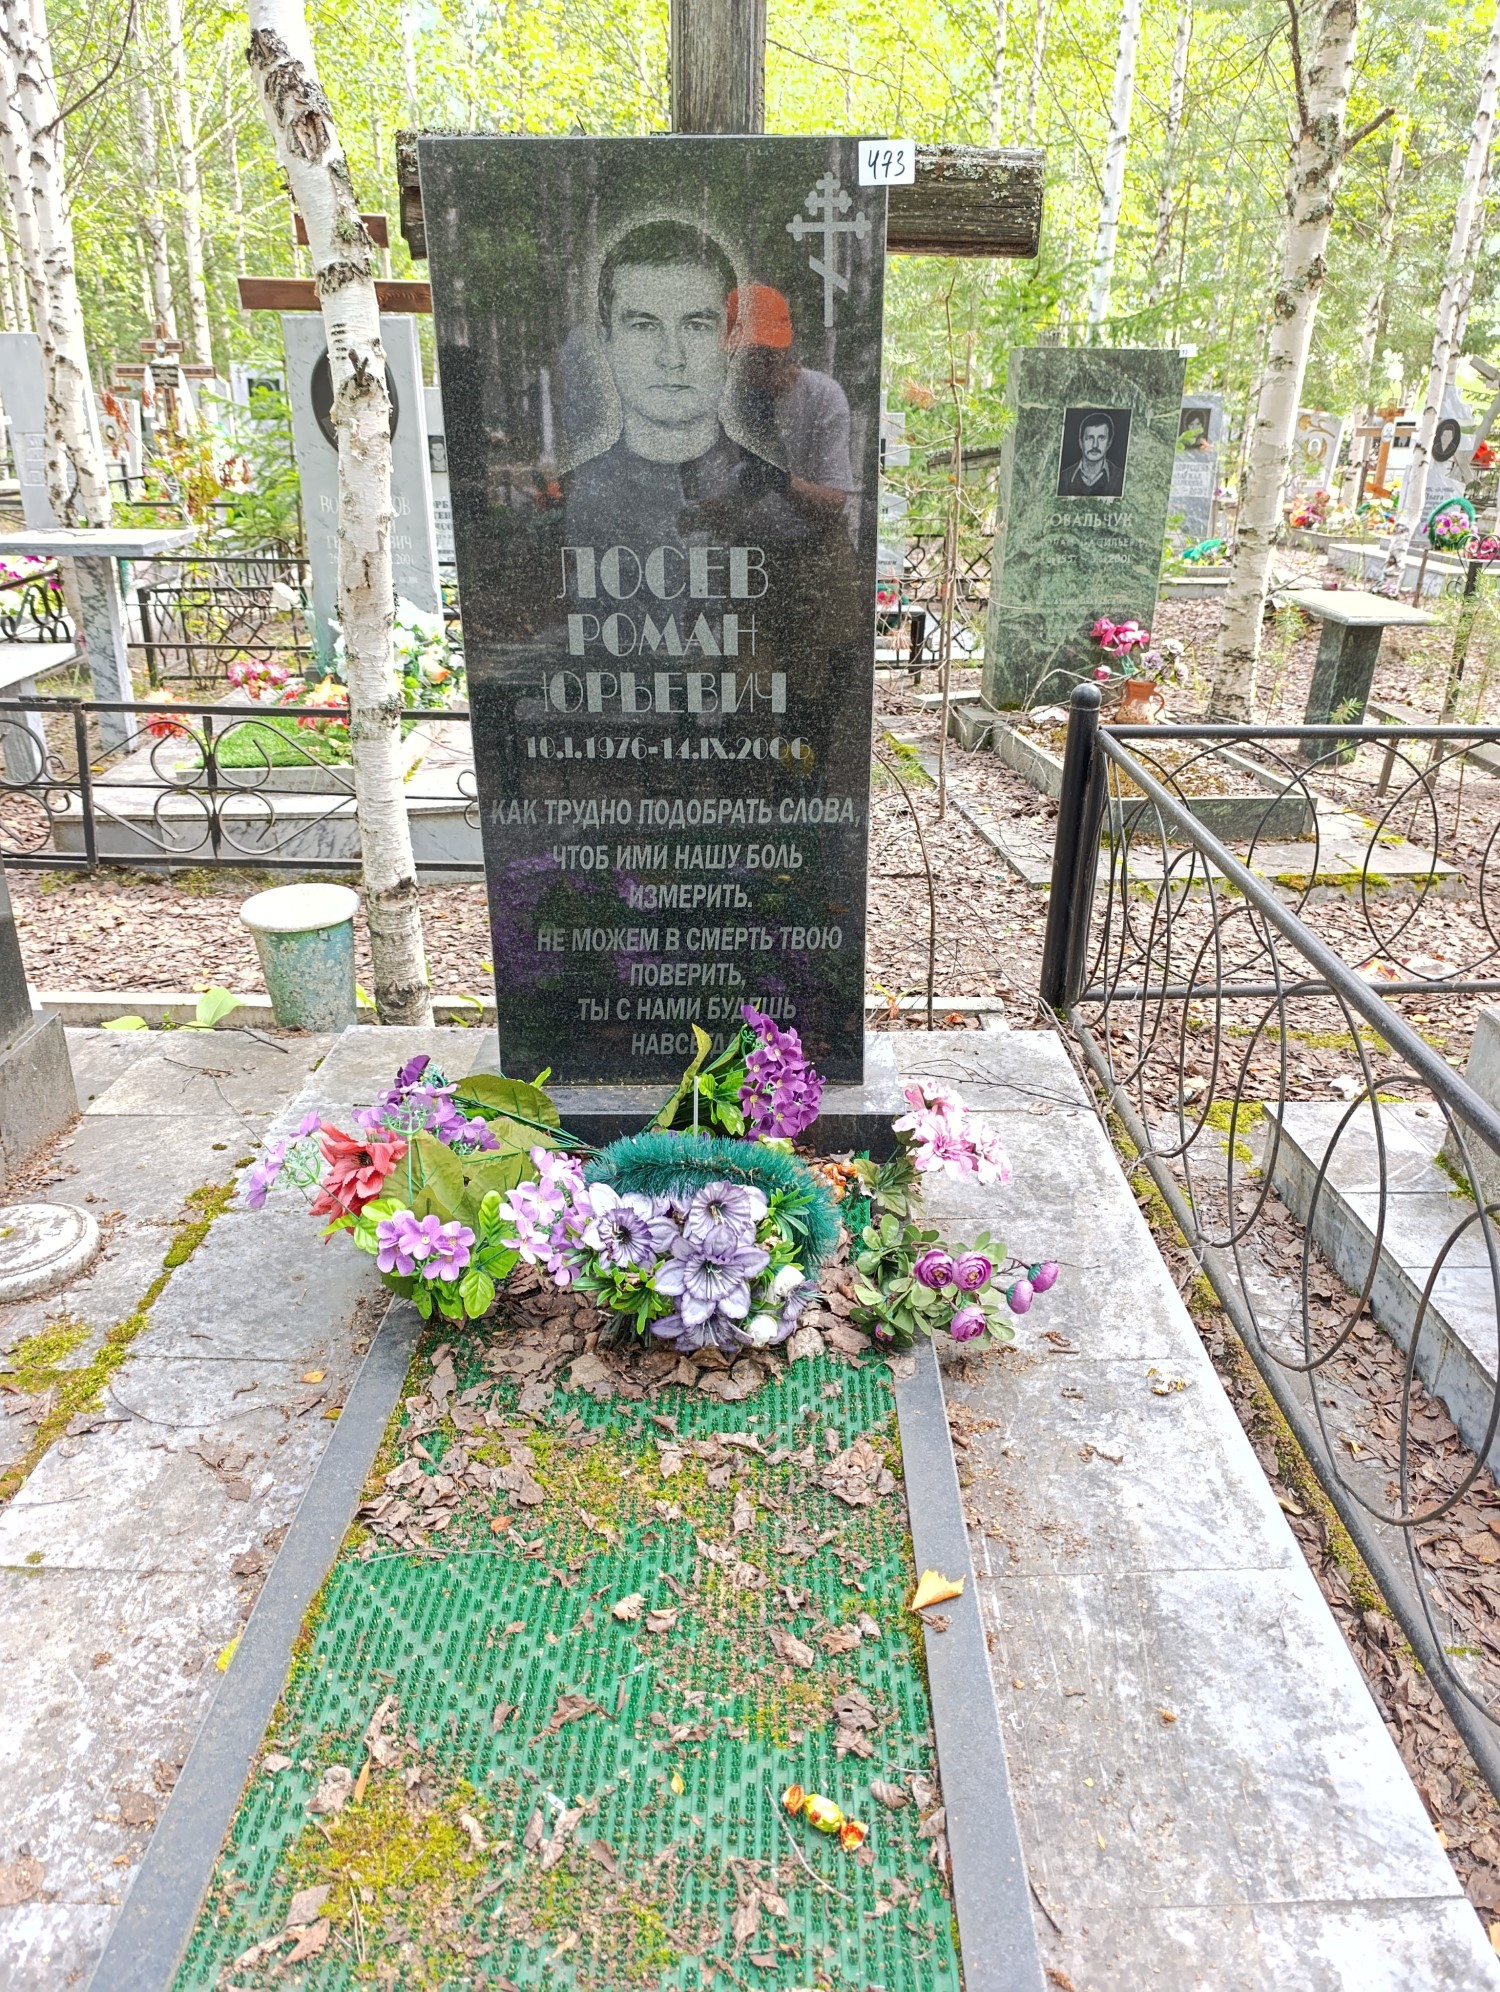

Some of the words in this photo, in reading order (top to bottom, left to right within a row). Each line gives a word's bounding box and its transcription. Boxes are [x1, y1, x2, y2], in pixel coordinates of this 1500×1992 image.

[868, 149, 905, 179] 473
[556, 545, 769, 600] ЛОСЕВ
[567, 612, 758, 657] РОМАН
[541, 670, 787, 714] ЮРЬЕВИЧ
[491, 799, 537, 825] КАК
[545, 799, 632, 830] ТРУДНО
[638, 798, 773, 829] ПОДОБРАТЬ
[779, 797, 861, 827] СЛОВА,
[553, 845, 610, 870] ЧТОБ
[616, 845, 668, 870] ИМИ
[674, 844, 741, 869] НАШУ
[746, 843, 803, 869] БОЛЬ
[628, 884, 753, 909] ИЗМЕРИТЬ.
[537, 928, 566, 952] НЕ
[572, 928, 659, 951] МОЖЕМ
[665, 927, 680, 951] В
[686, 926, 773, 951] СМЕРТЬ
[780, 926, 843, 950] ТВОЮ
[629, 963, 747, 988] ПОВЕРИТЬ,
[578, 999, 609, 1021] ТЫ
[616, 999, 631, 1020] С
[636, 998, 701, 1020] НАМИ
